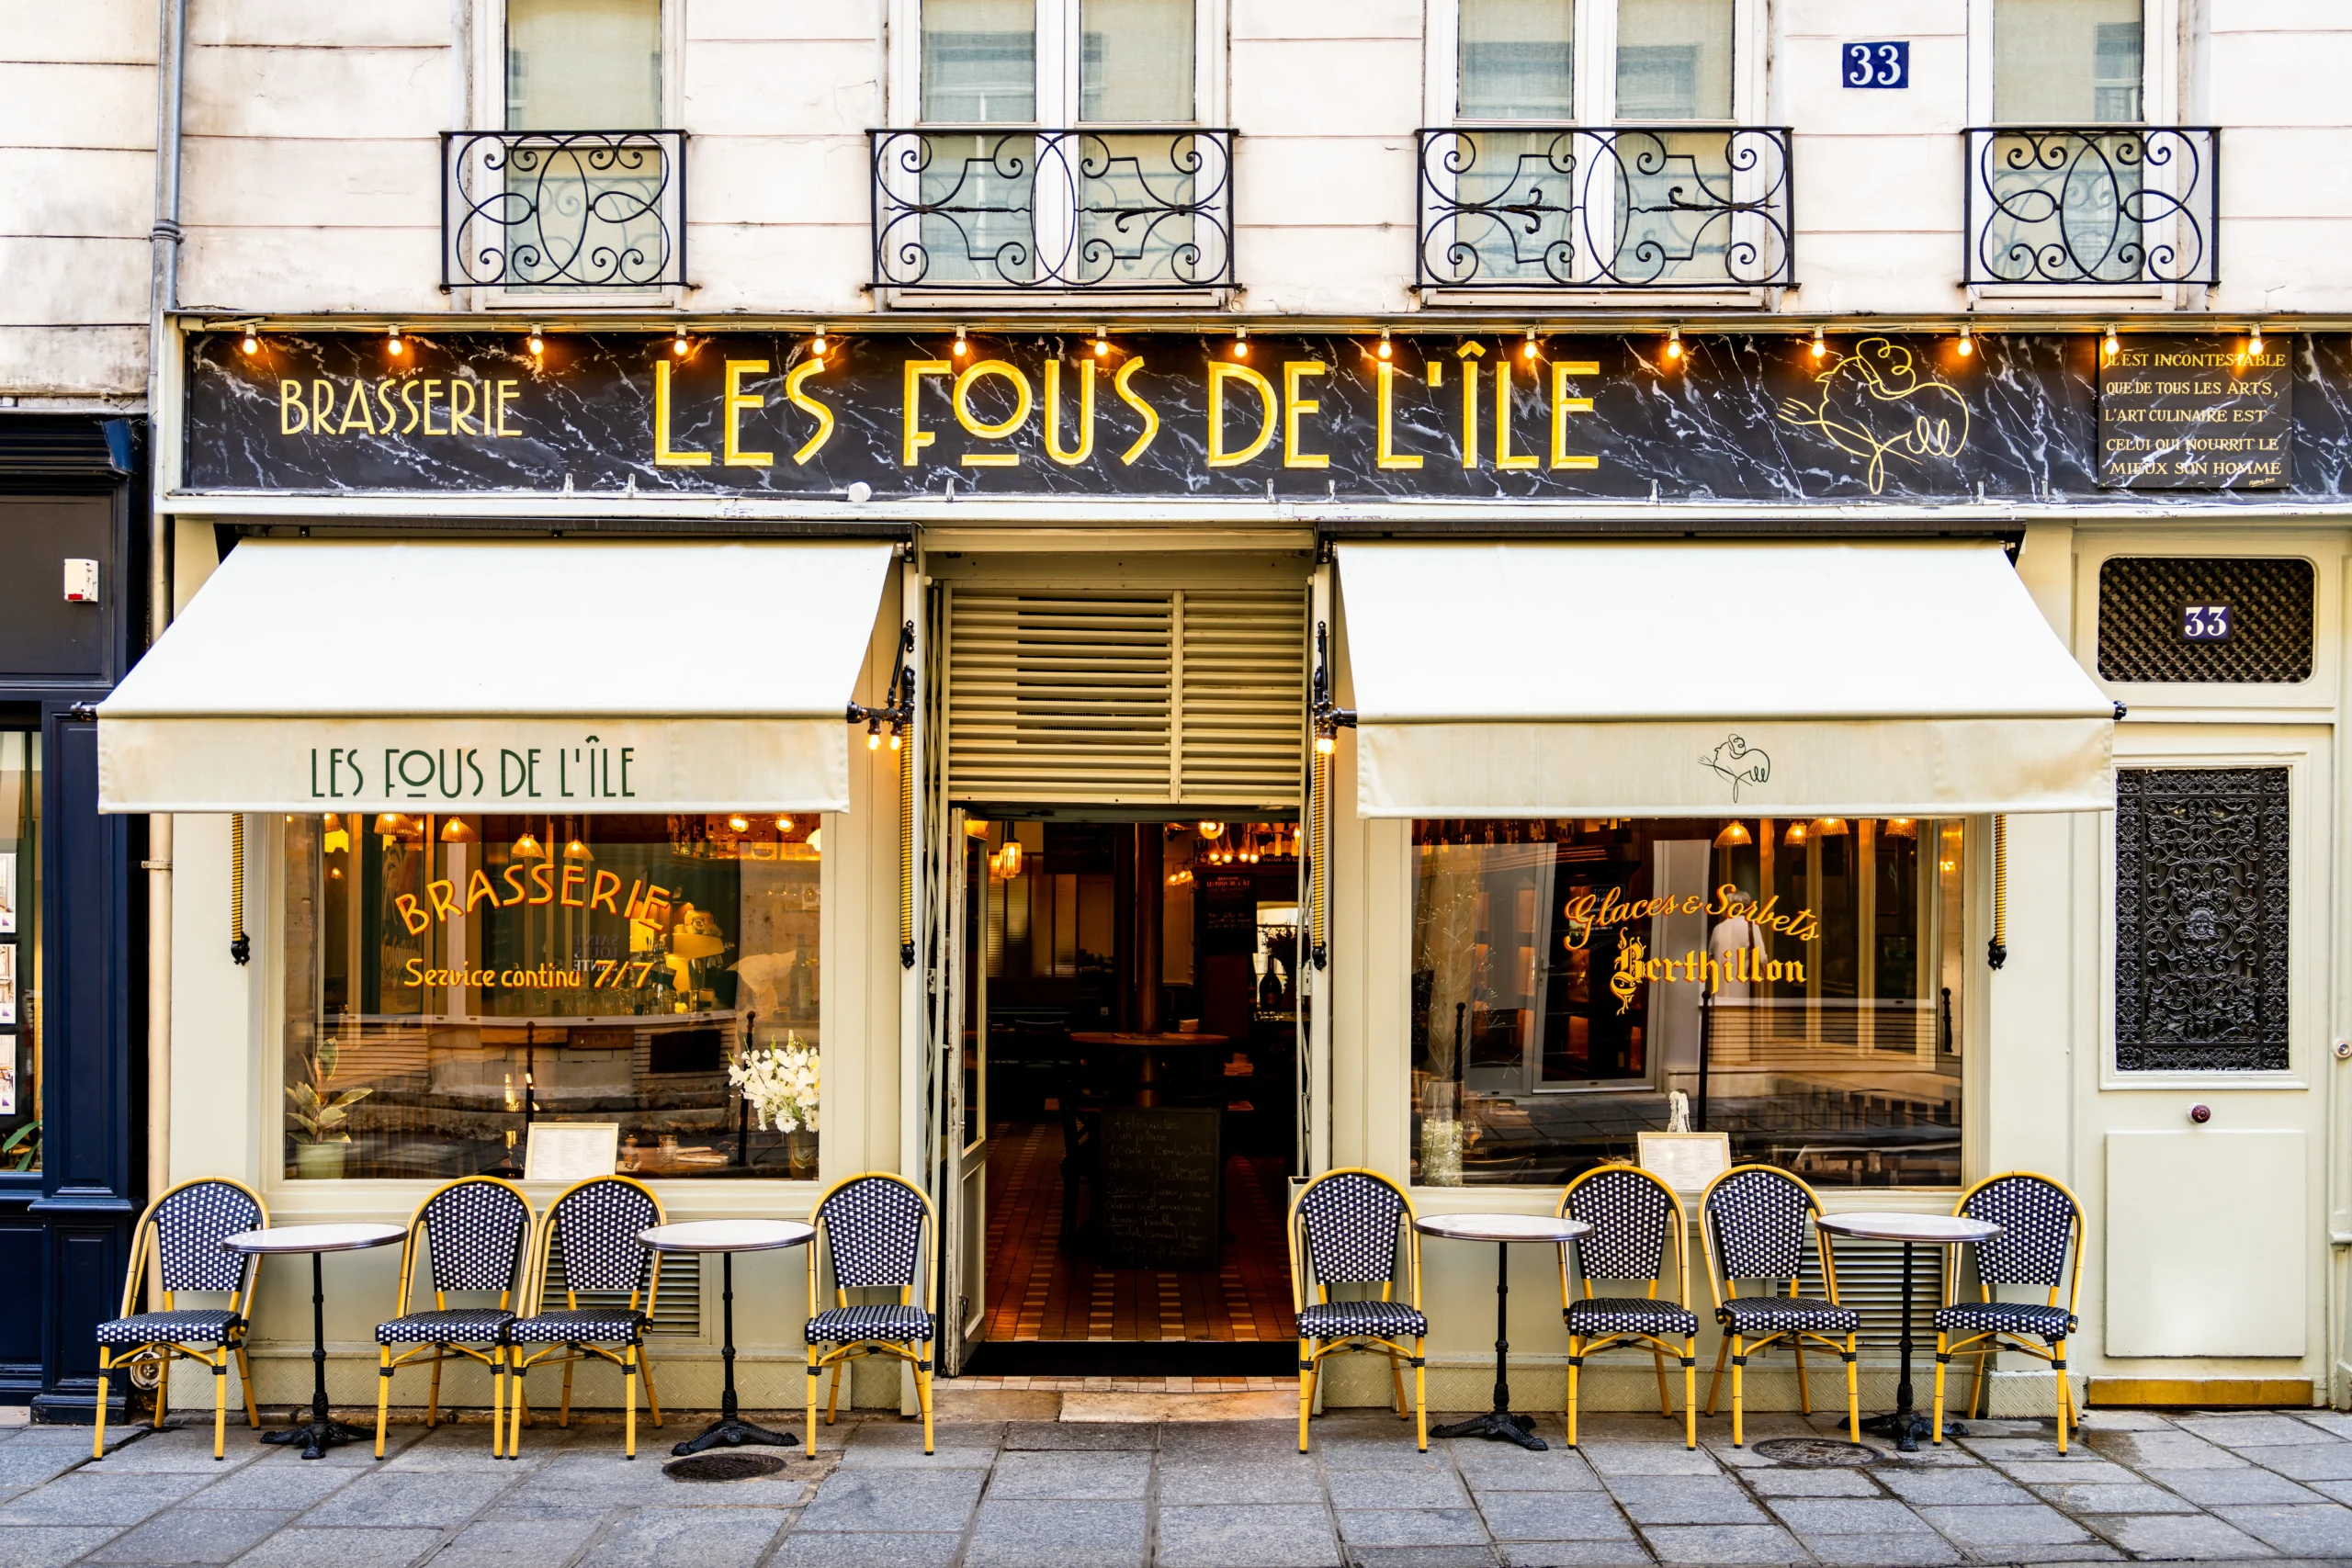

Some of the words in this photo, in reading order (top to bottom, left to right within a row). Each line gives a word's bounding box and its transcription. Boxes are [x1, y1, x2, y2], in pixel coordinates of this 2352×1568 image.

[1849, 44, 1901, 85] 33
[2122, 353, 2149, 367] EST
[2154, 353, 2286, 367] INCONTESTABLE
[280, 378, 524, 437] BRASSERIE
[655, 357, 834, 466] LES
[903, 355, 1159, 467] FOUS
[1208, 361, 1329, 468] DE
[1378, 341, 1600, 469] L'ÎLE
[2106, 381, 2135, 396] QUE
[2135, 382, 2153, 394] DE
[2155, 382, 2190, 395] TOUS
[2194, 381, 2222, 395] LES
[2227, 381, 2278, 399] ARTS,
[2104, 409, 2146, 423] L'ART
[2148, 410, 2228, 423] CULINAIRE
[2233, 410, 2268, 423] EST
[2106, 438, 2151, 451] CELUI
[2155, 438, 2180, 451] QUI
[2185, 438, 2256, 451] NOURRIT
[2258, 438, 2279, 451] LE
[2109, 462, 2169, 475] MIEUX
[2174, 462, 2209, 475] SON
[2212, 462, 2282, 475] HOMME
[2185, 606, 2226, 636] 33
[311, 748, 364, 797] LES
[385, 748, 483, 798] FOUS
[501, 749, 541, 797] DE
[560, 735, 636, 797] L'ÎLE
[394, 863, 672, 937] BRASSERIE
[1564, 886, 1678, 951] Glaces
[1681, 896, 1702, 914] &
[1704, 884, 1819, 942] Sorbets
[403, 958, 496, 987] Service
[501, 963, 581, 988] continu
[593, 959, 655, 989] 7/7
[1610, 927, 1807, 1016] Berthillon
